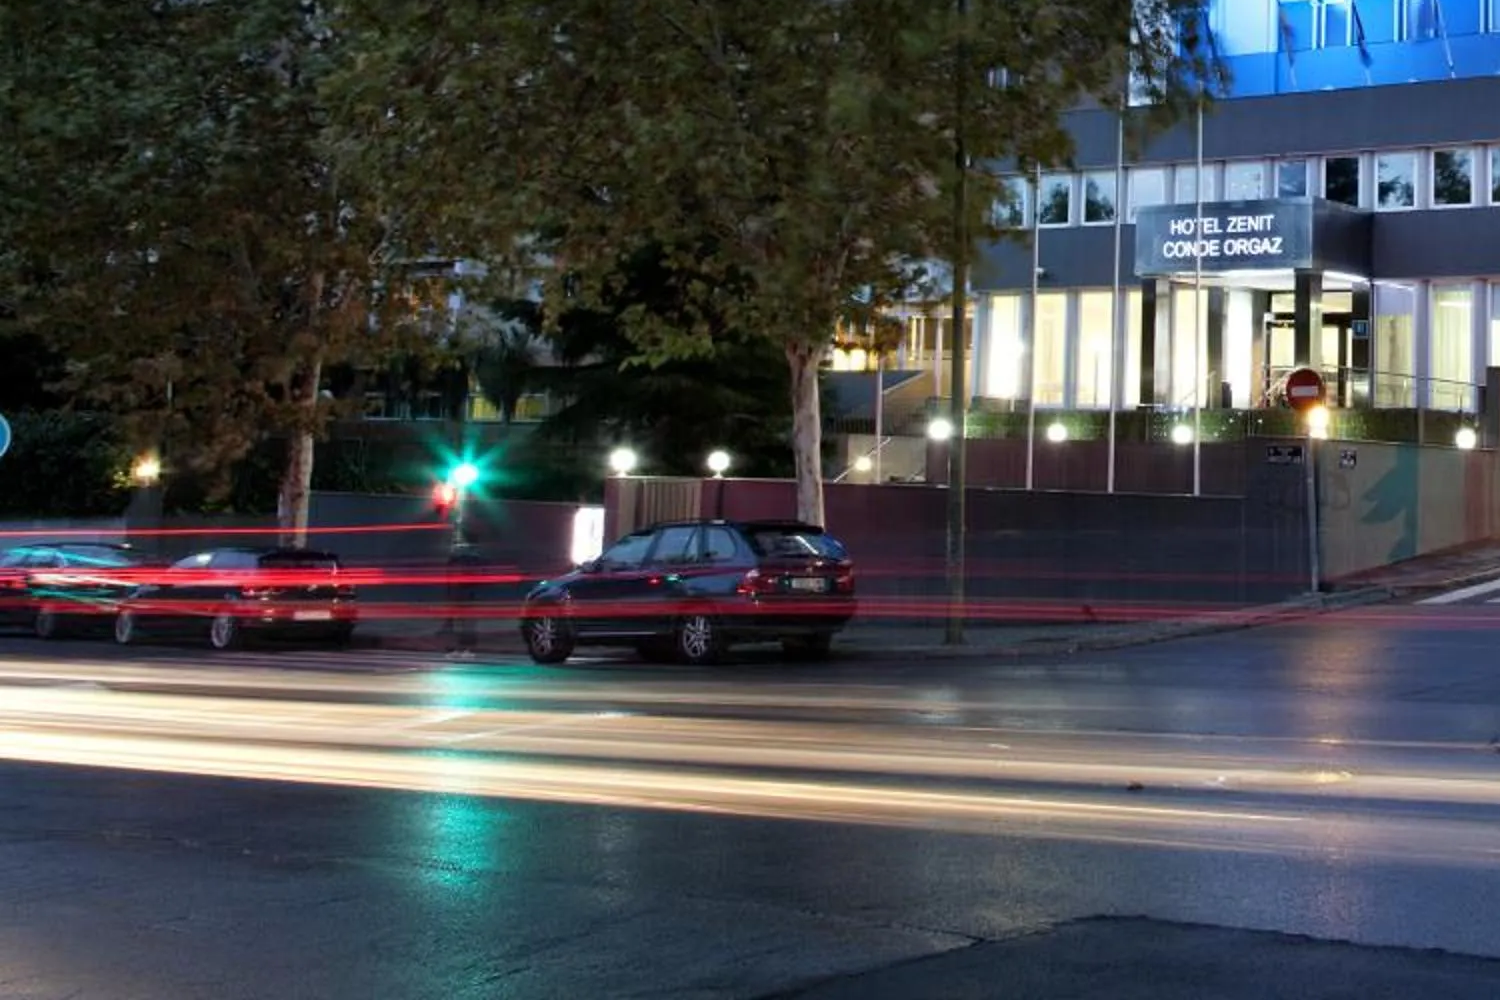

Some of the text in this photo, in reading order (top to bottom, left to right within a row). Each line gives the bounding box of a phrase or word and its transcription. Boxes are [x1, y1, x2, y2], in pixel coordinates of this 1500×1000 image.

[1226, 214, 1275, 233] ZENIT
[1163, 236, 1283, 258] CONDE ORGAZ
